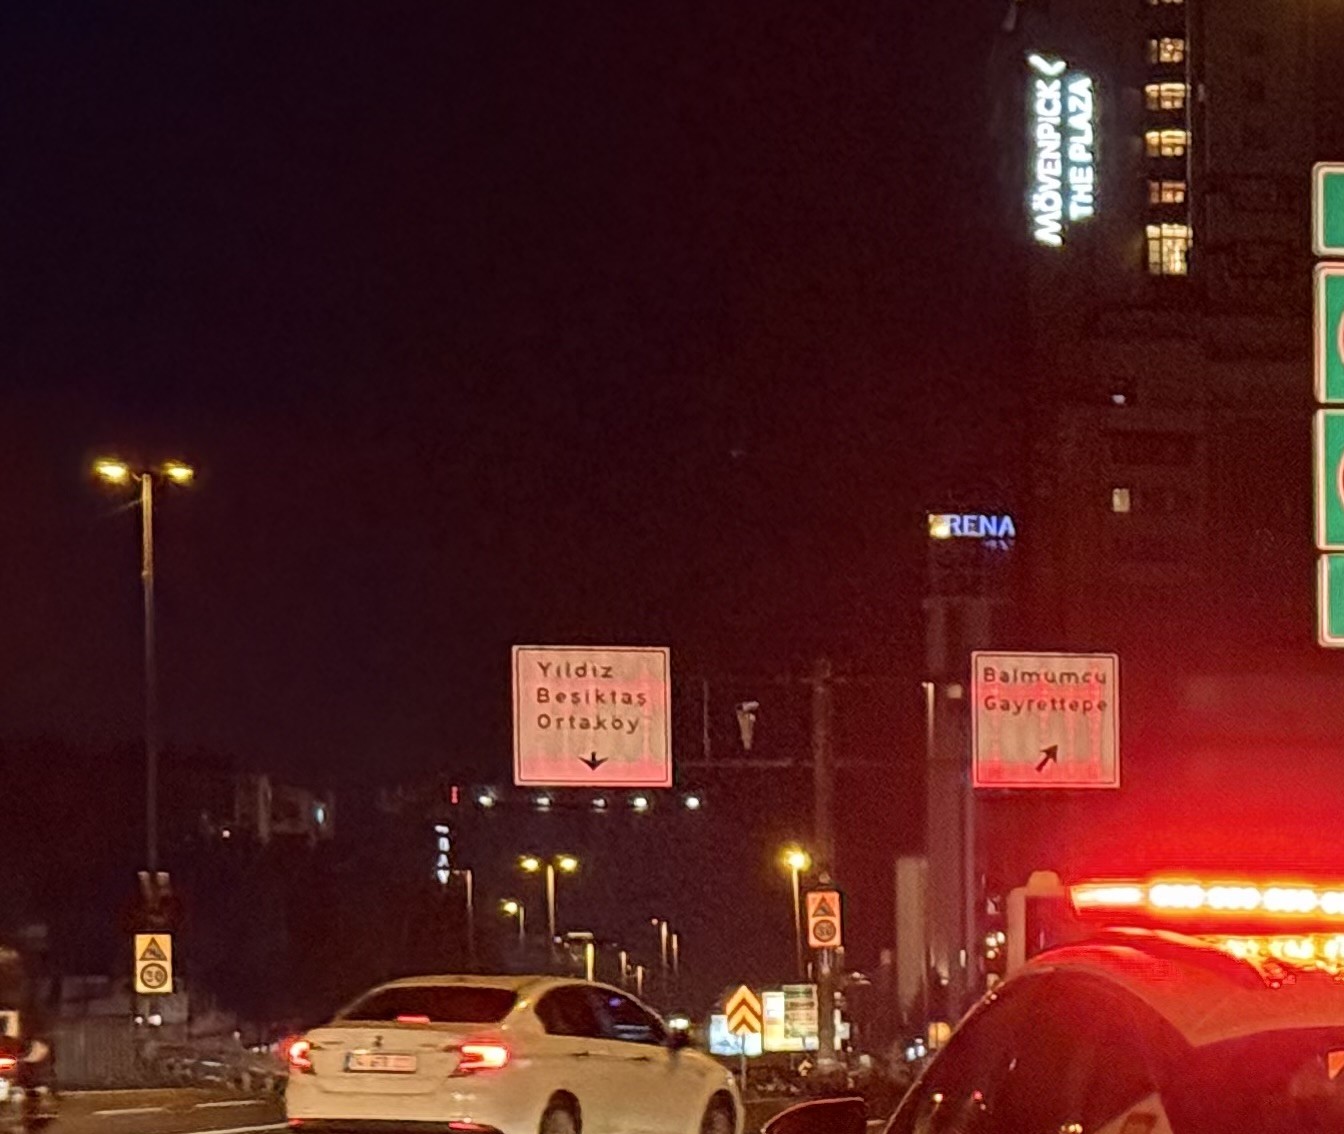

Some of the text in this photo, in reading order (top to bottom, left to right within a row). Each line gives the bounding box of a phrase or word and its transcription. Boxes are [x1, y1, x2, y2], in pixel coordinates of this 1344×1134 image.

[1067, 76, 1094, 221] THE PLAZA
[929, 513, 1016, 538] RENA
[983, 667, 1107, 684] Balmumcu
[984, 695, 1107, 716] Gayrettepe
